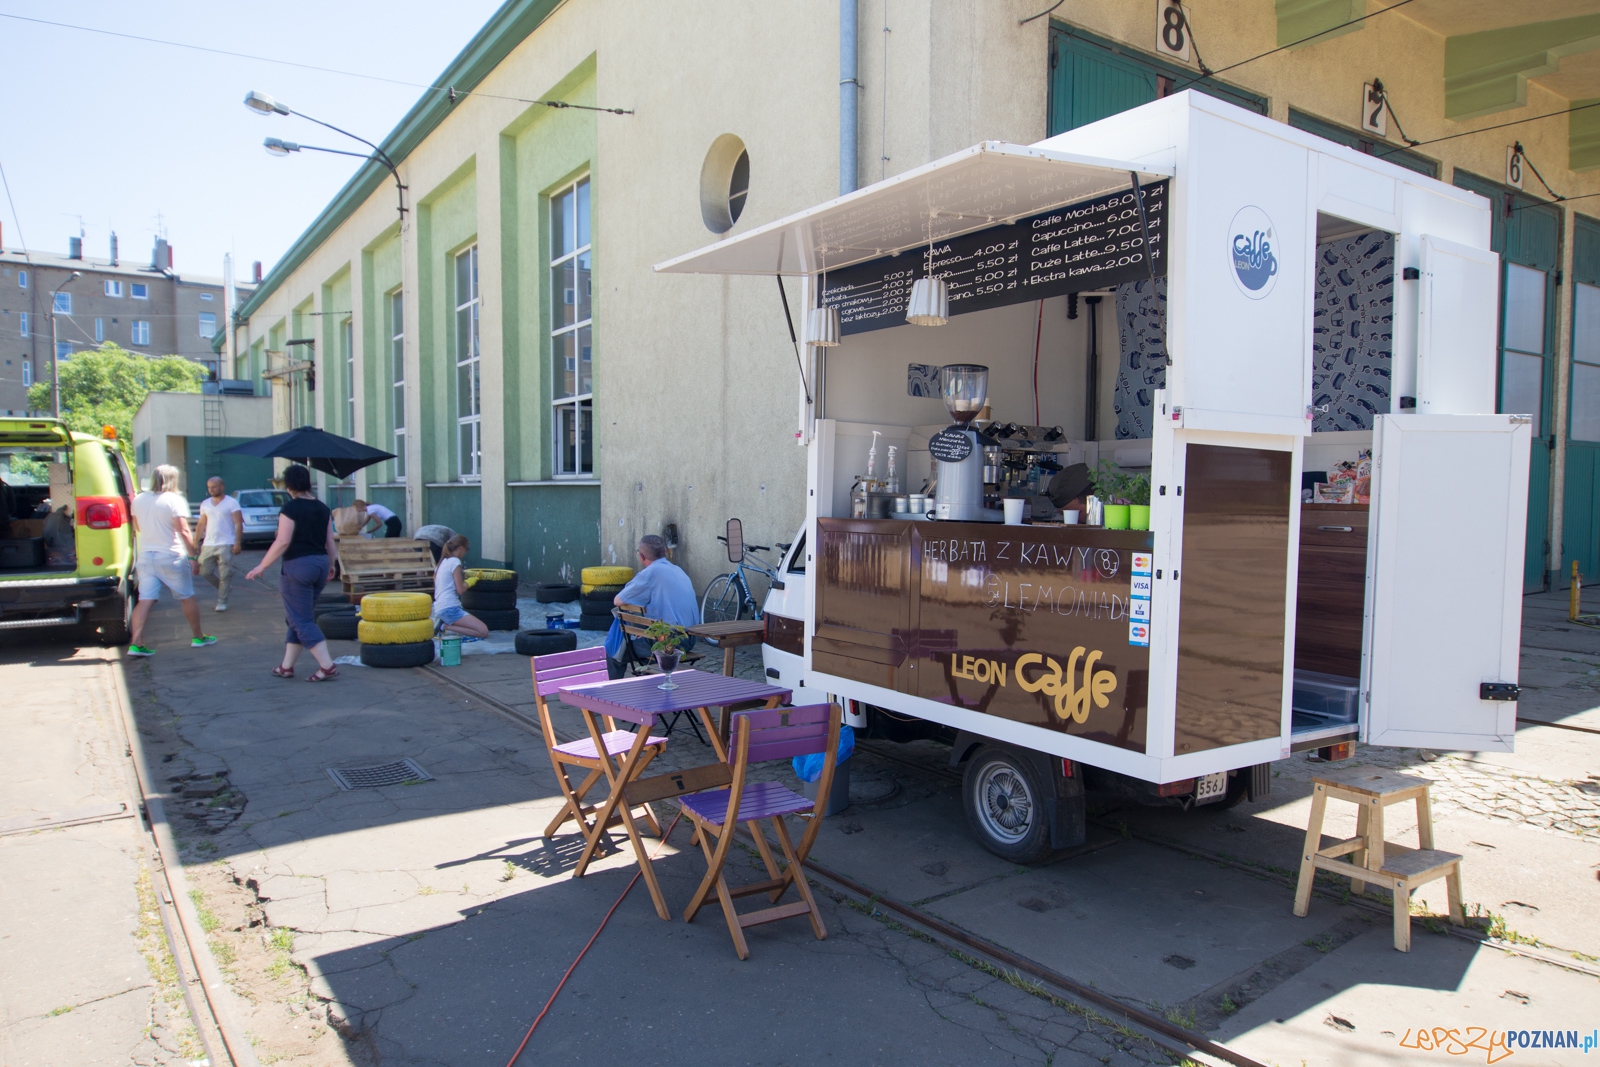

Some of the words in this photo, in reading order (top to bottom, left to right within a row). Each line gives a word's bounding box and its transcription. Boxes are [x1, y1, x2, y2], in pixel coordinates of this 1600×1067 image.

[1163, 6, 1184, 51] 8
[1368, 90, 1383, 128] 7
[1510, 153, 1520, 183] 6
[1032, 215, 1062, 229] Caffe
[1151, 185, 1164, 196] zł
[1149, 201, 1163, 213] zł
[1008, 239, 1019, 250] zł
[1031, 242, 1061, 257] Caffe
[1148, 217, 1161, 229] zł
[977, 257, 1005, 270] 5.50
[1008, 253, 1019, 264] zł
[1031, 256, 1062, 271] Duże
[1234, 260, 1250, 270] LEON
[883, 271, 905, 281] 5.00
[975, 270, 1004, 284] 5.00
[1007, 267, 1018, 278] zł
[882, 288, 904, 299] 2.00
[976, 283, 1004, 296] 5.50
[1007, 280, 1018, 290] zł
[841, 315, 853, 323] bez
[924, 540, 987, 562] HERBATA
[997, 542, 1010, 560] Z
[1021, 543, 1090, 569] KAWY
[1133, 582, 1149, 590] VISA
[1004, 581, 1130, 622] LEMONIADA
[952, 653, 1007, 688] LEON
[1199, 778, 1225, 796] 556J
